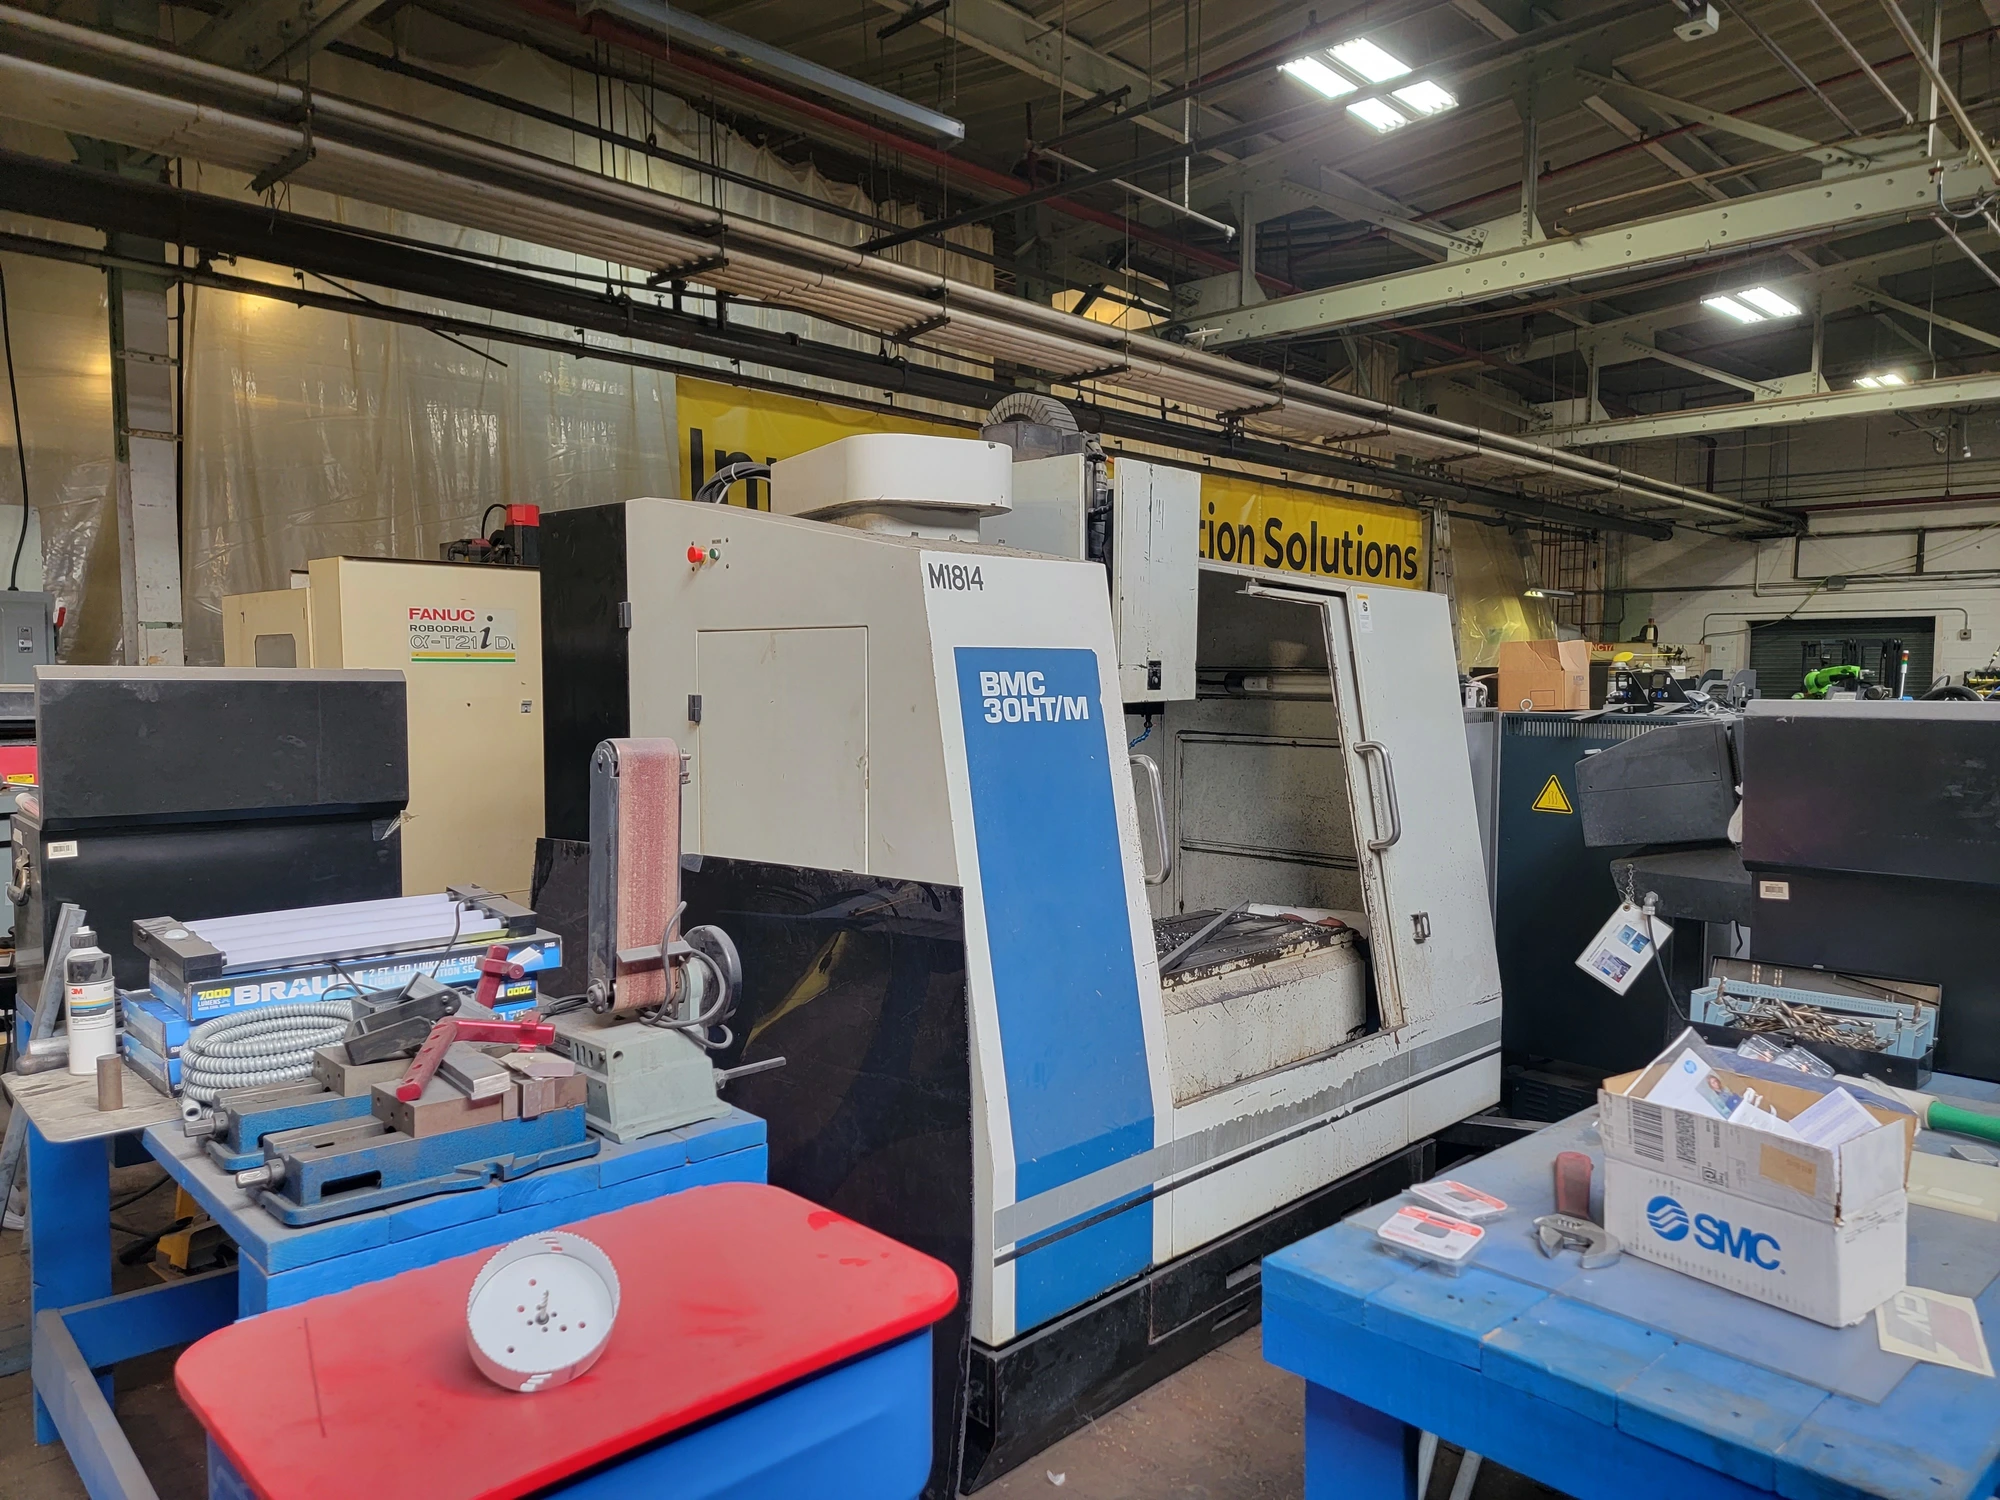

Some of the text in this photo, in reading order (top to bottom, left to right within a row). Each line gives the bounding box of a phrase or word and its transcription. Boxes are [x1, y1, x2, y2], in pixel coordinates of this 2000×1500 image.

[689, 427, 777, 512] In
[1263, 517, 1418, 580] Solutions
[928, 563, 984, 591] M1814
[408, 607, 476, 622] FANUC
[409, 624, 476, 633] ROBODRILL
[979, 671, 1046, 697] BMC
[983, 695, 1089, 724] 30HT/M
[368, 968, 376, 977] 2
[394, 964, 411, 973] LED
[414, 957, 458, 971] LINKABLE
[459, 955, 483, 966] SHO
[234, 969, 364, 1006] BRAUN
[1693, 1212, 1782, 1271] SMC
